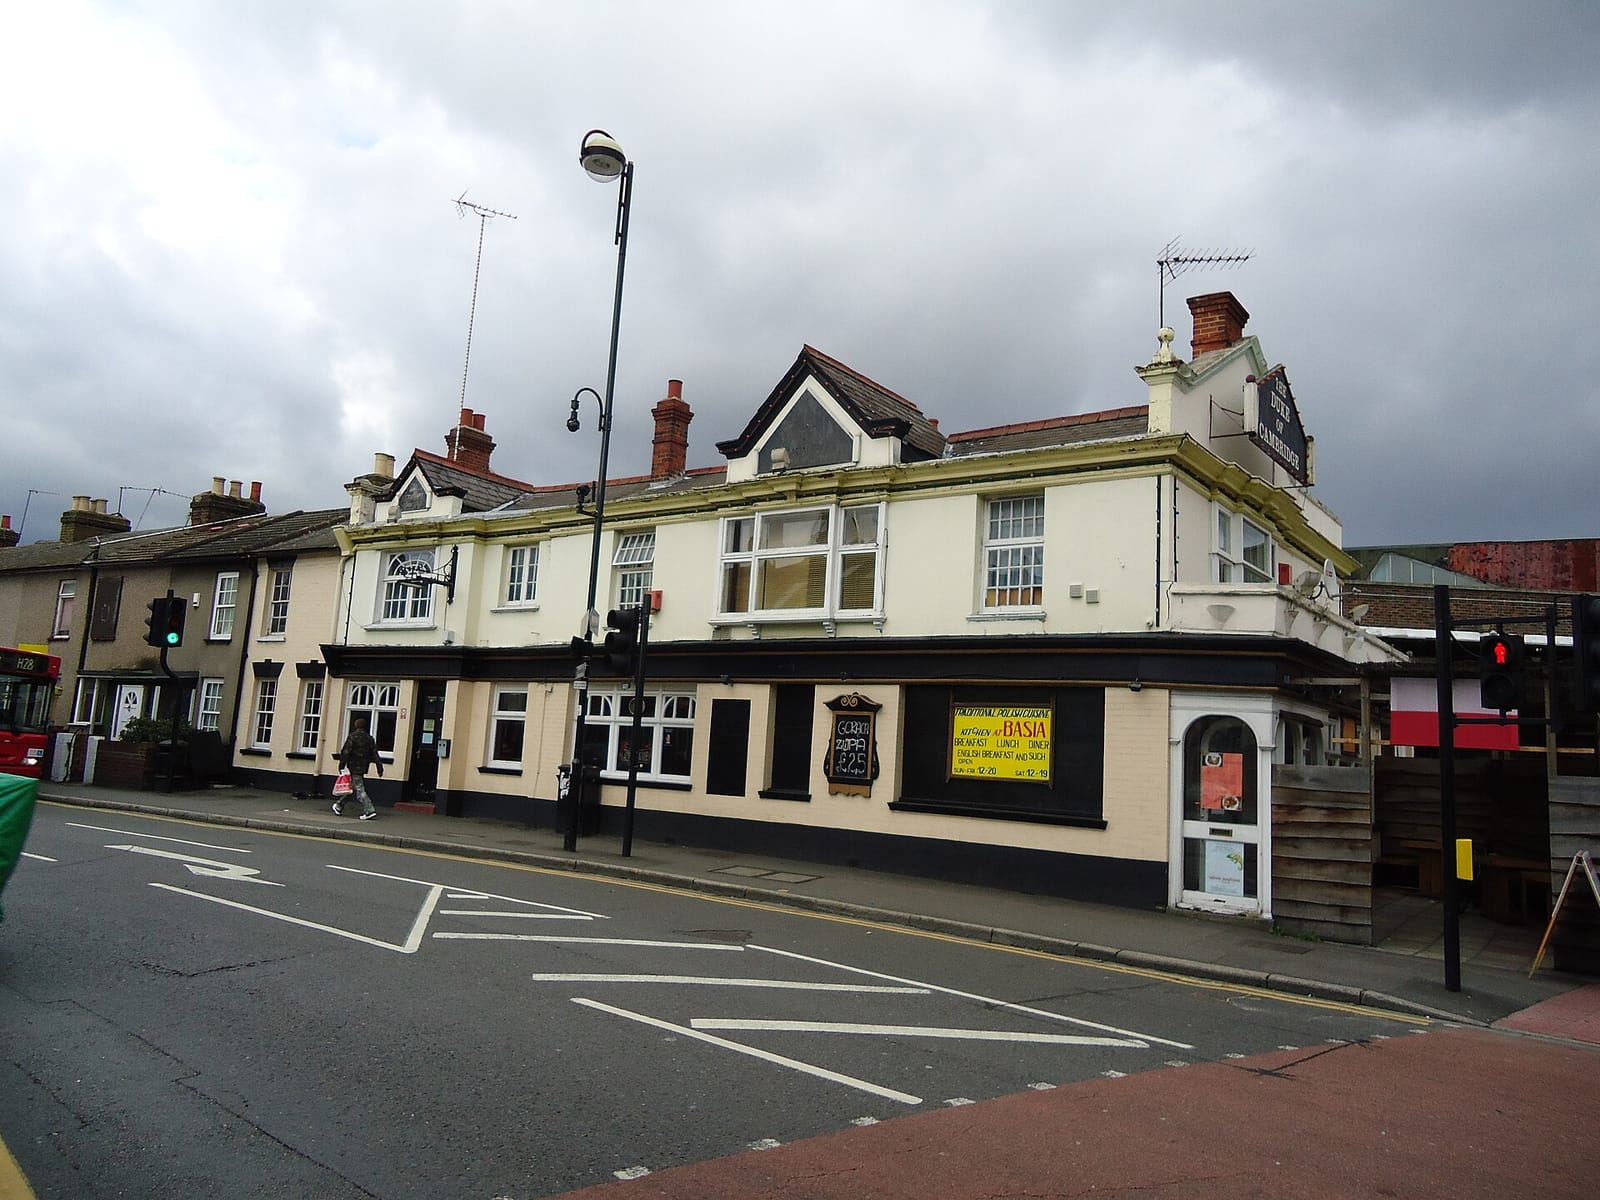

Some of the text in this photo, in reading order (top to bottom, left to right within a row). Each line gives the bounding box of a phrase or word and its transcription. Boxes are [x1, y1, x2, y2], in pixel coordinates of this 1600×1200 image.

[1271, 390, 1290, 423] DUKE
[1259, 422, 1300, 471] CAMBRIDGE
[17, 658, 34, 670] H28
[960, 727, 991, 736] KITCHEN
[1003, 720, 1046, 738] BASIA
[954, 738, 1049, 749] BREAKFAST LUNCH DINER
[957, 749, 1046, 761] ENGLISH BREAKFAST AND SUCH
